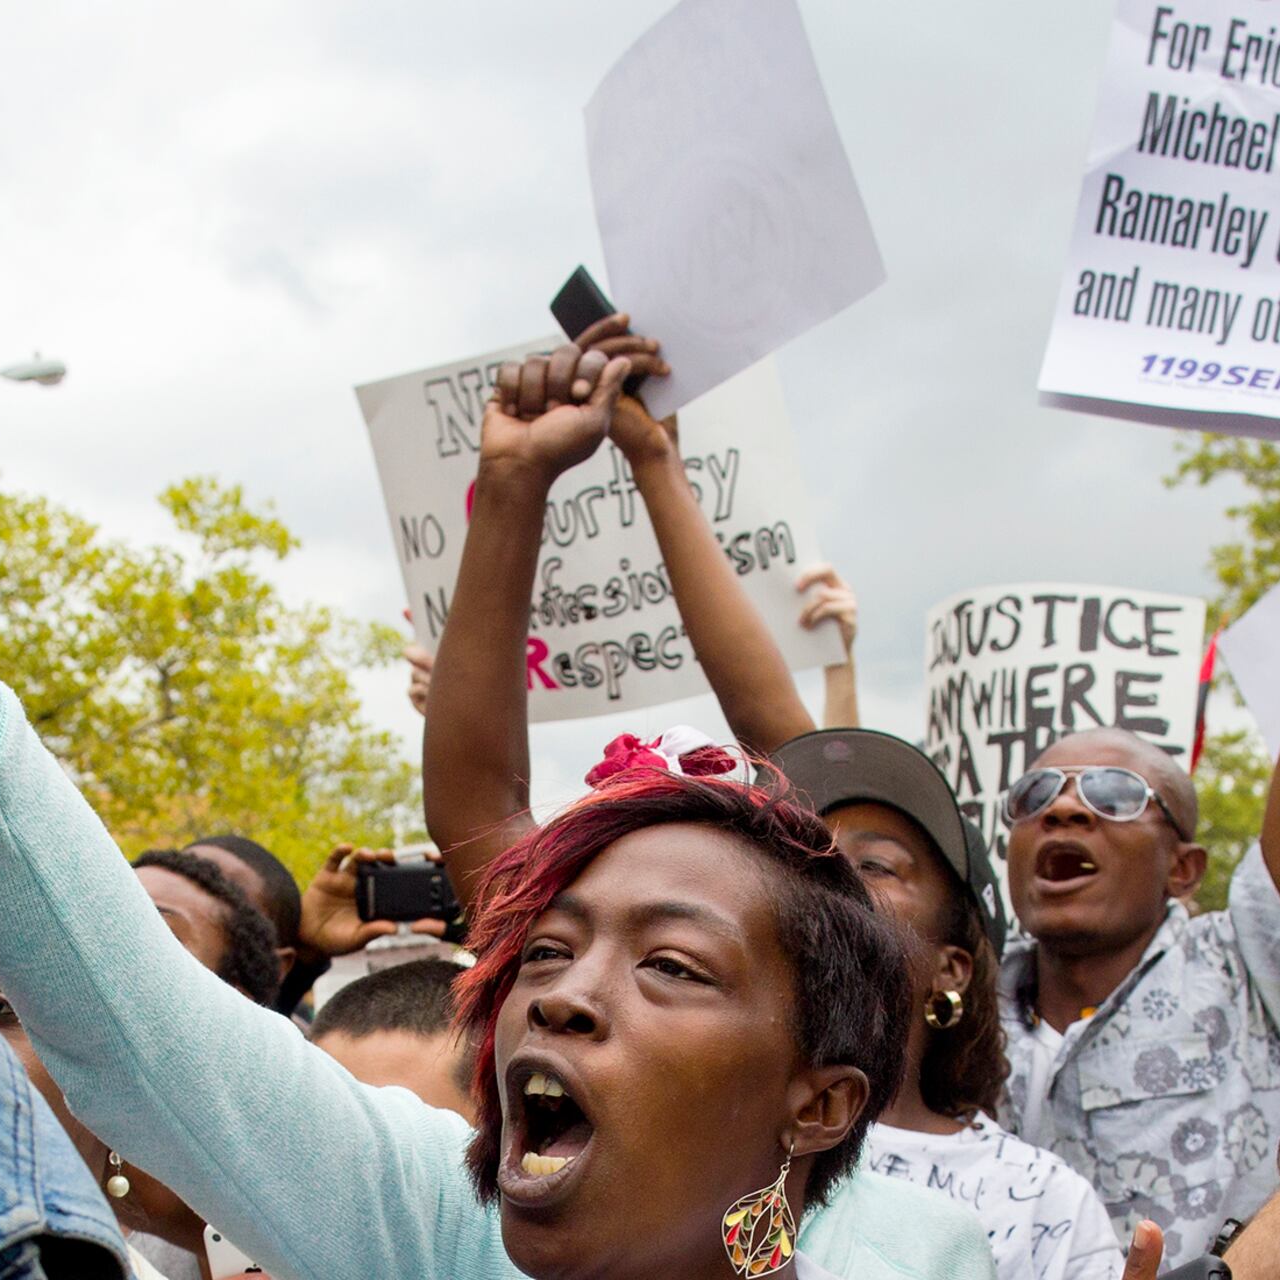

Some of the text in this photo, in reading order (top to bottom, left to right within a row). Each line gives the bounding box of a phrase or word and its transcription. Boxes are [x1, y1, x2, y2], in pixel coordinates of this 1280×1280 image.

[1147, 7, 1211, 72] For
[1137, 92, 1280, 173] Michael
[1094, 173, 1268, 269] Ramarley
[1073, 266, 1140, 323] and
[1146, 280, 1242, 345] many
[400, 513, 446, 561] NO
[929, 594, 1183, 672] INJUSTICE
[928, 663, 1170, 745] ANYWHERE
